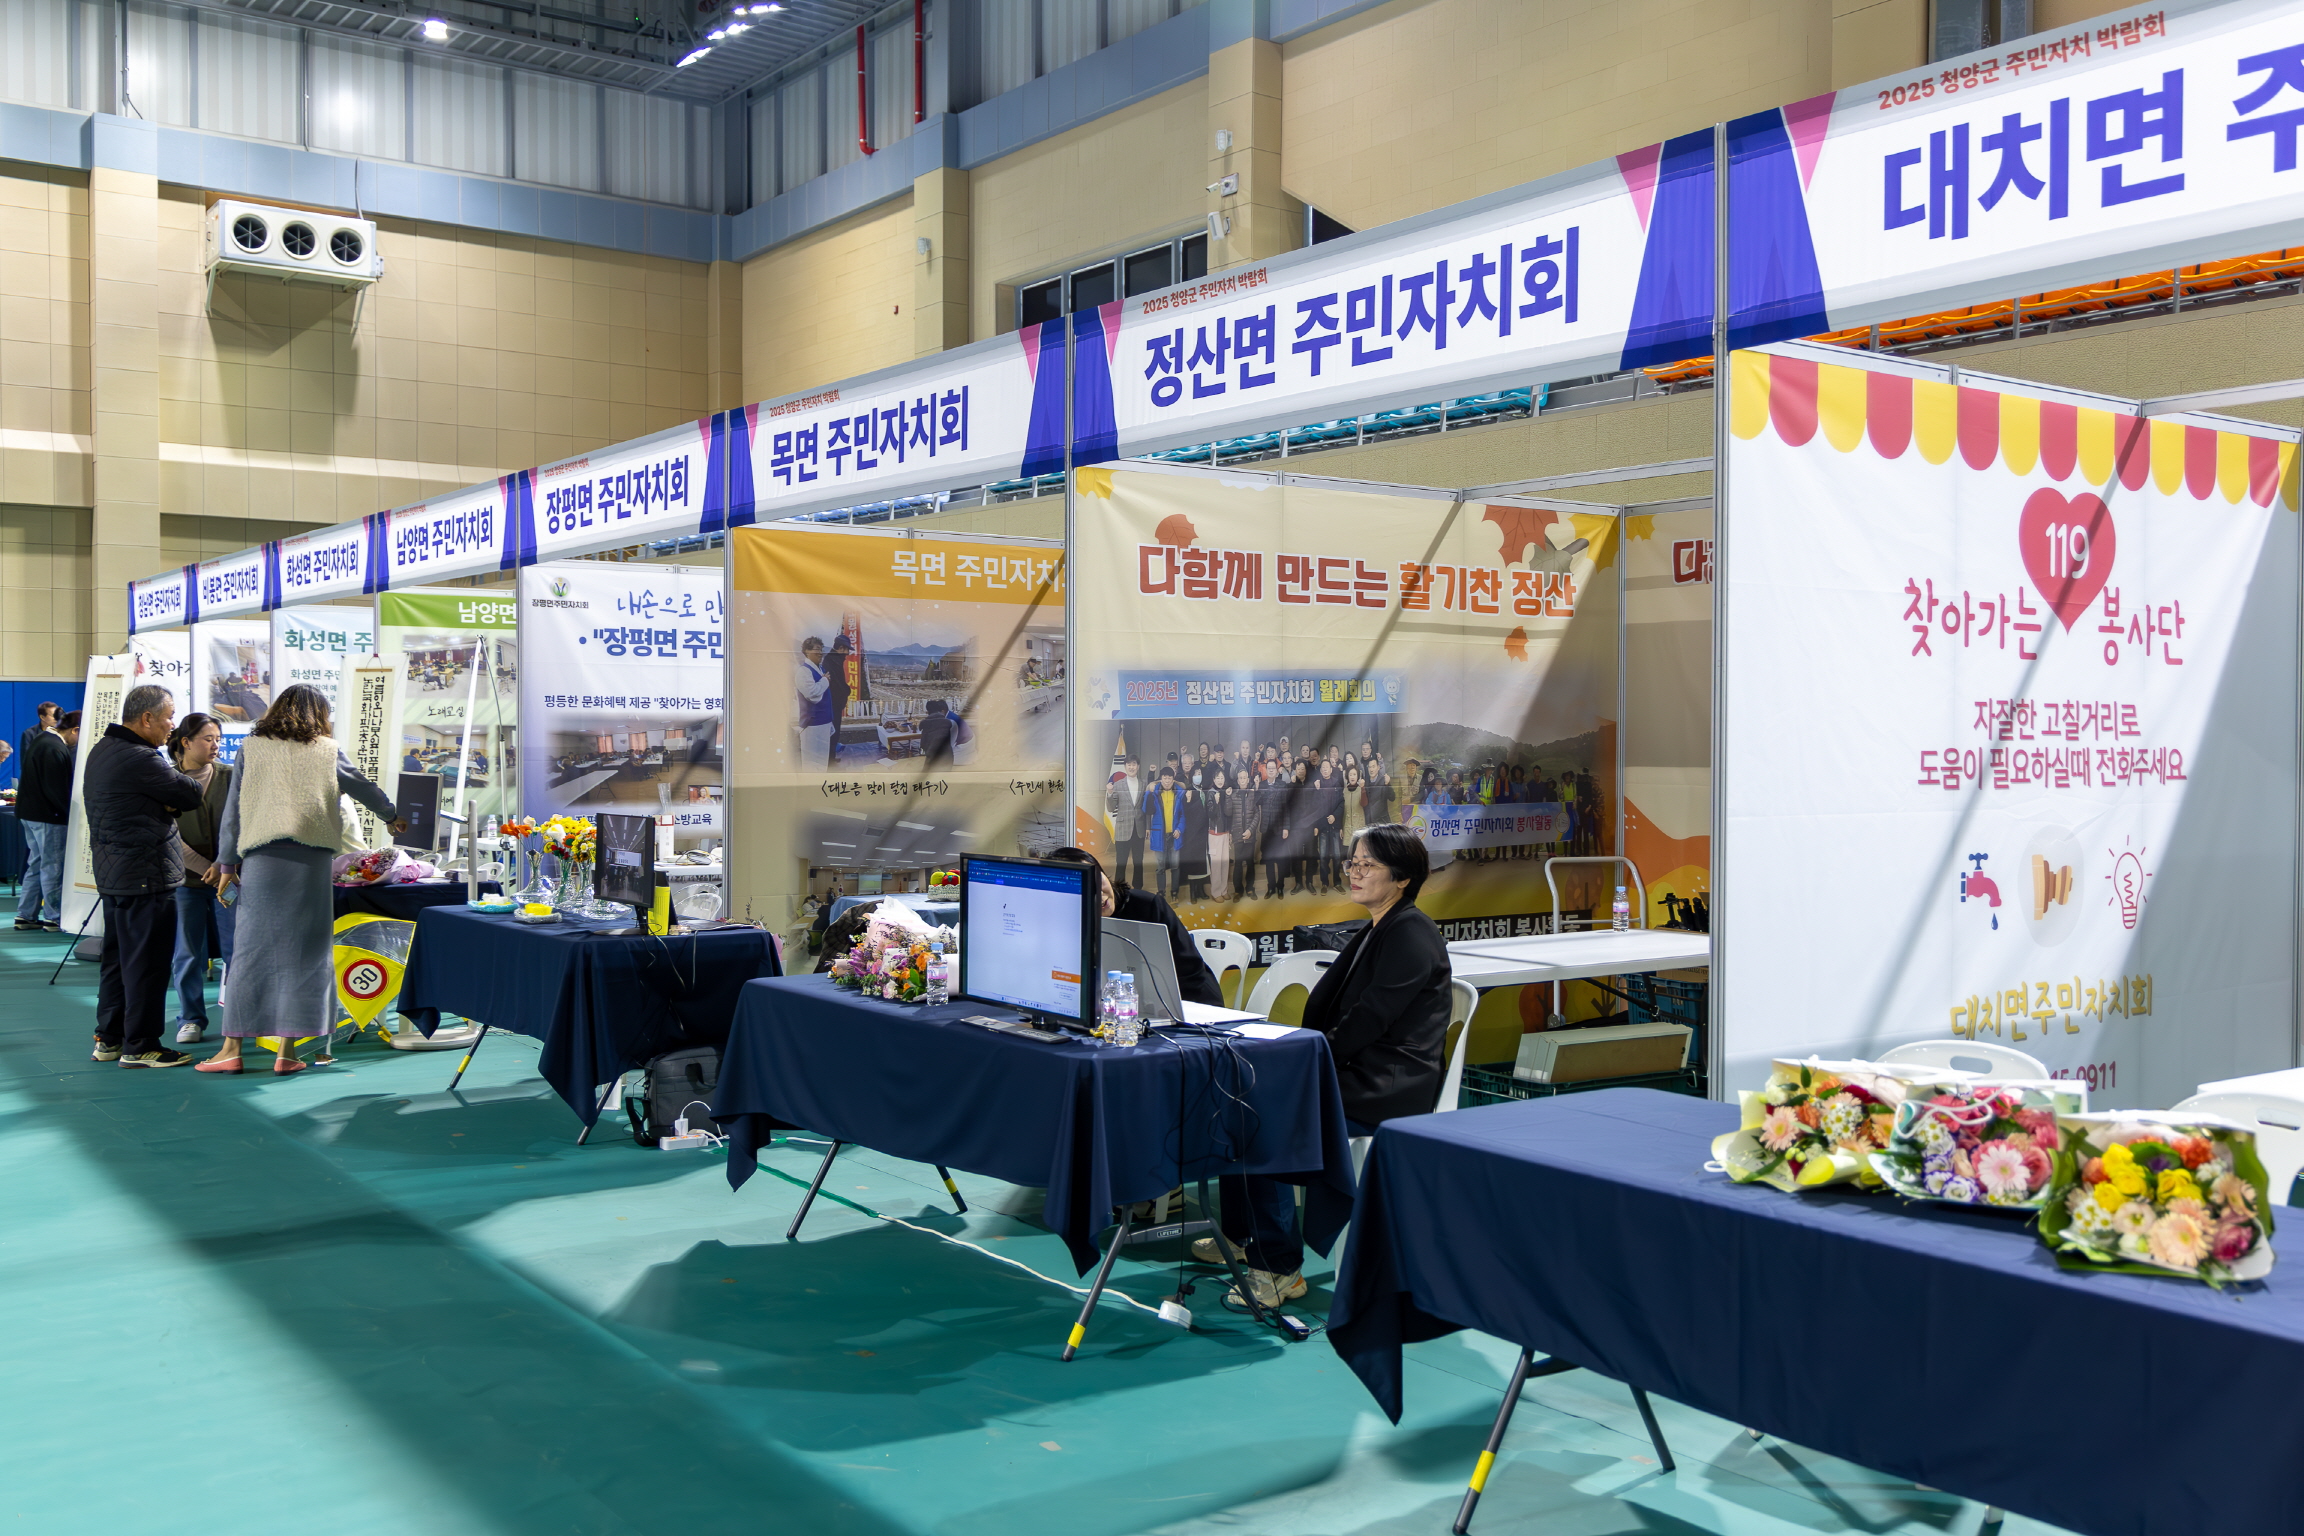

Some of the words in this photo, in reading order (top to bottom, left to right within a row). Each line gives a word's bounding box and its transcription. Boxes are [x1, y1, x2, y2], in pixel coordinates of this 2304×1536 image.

[1878, 77, 1935, 111] 2025
[1939, 58, 2000, 94] 청양군
[2006, 31, 2090, 77] 주민자치
[2096, 11, 2166, 50] 박람회
[1883, 67, 2185, 241] 대치면
[1142, 296, 1169, 315] 2025
[1170, 286, 1197, 309] 청양군
[1199, 275, 1237, 301] 주민자치
[1238, 267, 1268, 292] 박람회
[1144, 305, 1276, 408] 정산면
[1291, 225, 1580, 378] 주민자치회
[769, 404, 785, 418] 2025
[770, 422, 819, 486] 목면
[825, 384, 969, 477] 주민자치회
[546, 479, 593, 535] 장평면
[598, 454, 689, 524] 주민자치회
[396, 520, 429, 566] 남양면
[431, 505, 493, 558] 주민자치회
[2045, 522, 2089, 579] 119
[286, 550, 311, 588] 화성면
[313, 539, 359, 583] 주민자치회
[890, 550, 946, 586] 목면
[954, 554, 1066, 593] 주민자치
[1137, 543, 1263, 601] 다함께
[1276, 552, 1389, 610] 만드는
[1398, 560, 1503, 617] 활기찬
[1510, 572, 1577, 619] 정산
[1672, 539, 1713, 584] 다
[154, 583, 182, 615] 주민자치회
[202, 574, 222, 605] 비봉면
[223, 564, 259, 600] 주민자치회
[531, 598, 590, 609] 장평면주민자치회
[617, 589, 696, 619] 내손으로
[458, 601, 517, 625] 남양면
[1903, 577, 2042, 660] 찾아가는
[2098, 586, 2185, 666] 봉사단
[284, 629, 347, 652] 화성면
[290, 669, 321, 680] 화성면
[1126, 680, 1179, 702] 2025년
[1185, 680, 1235, 705] 정산면
[1239, 679, 1315, 705] 주민자치회
[1319, 679, 1377, 703] 월례회의
[544, 694, 579, 708] 평등한
[581, 695, 626, 708] 문화혜택
[629, 696, 651, 709] 제공
[653, 696, 702, 710] "찾아가는
[1973, 698, 2038, 741] 자잘한
[2041, 699, 2141, 741] 고칠거리로
[1917, 746, 1984, 790] 도움이
[1989, 746, 2091, 792] 필요하실때
[2095, 747, 2188, 788] 전화주세요
[1430, 818, 1460, 838] 정산면
[1463, 817, 1515, 835] 주민자치회
[353, 966, 379, 992] 30
[1949, 974, 2153, 1042] 대치면주민자치회
